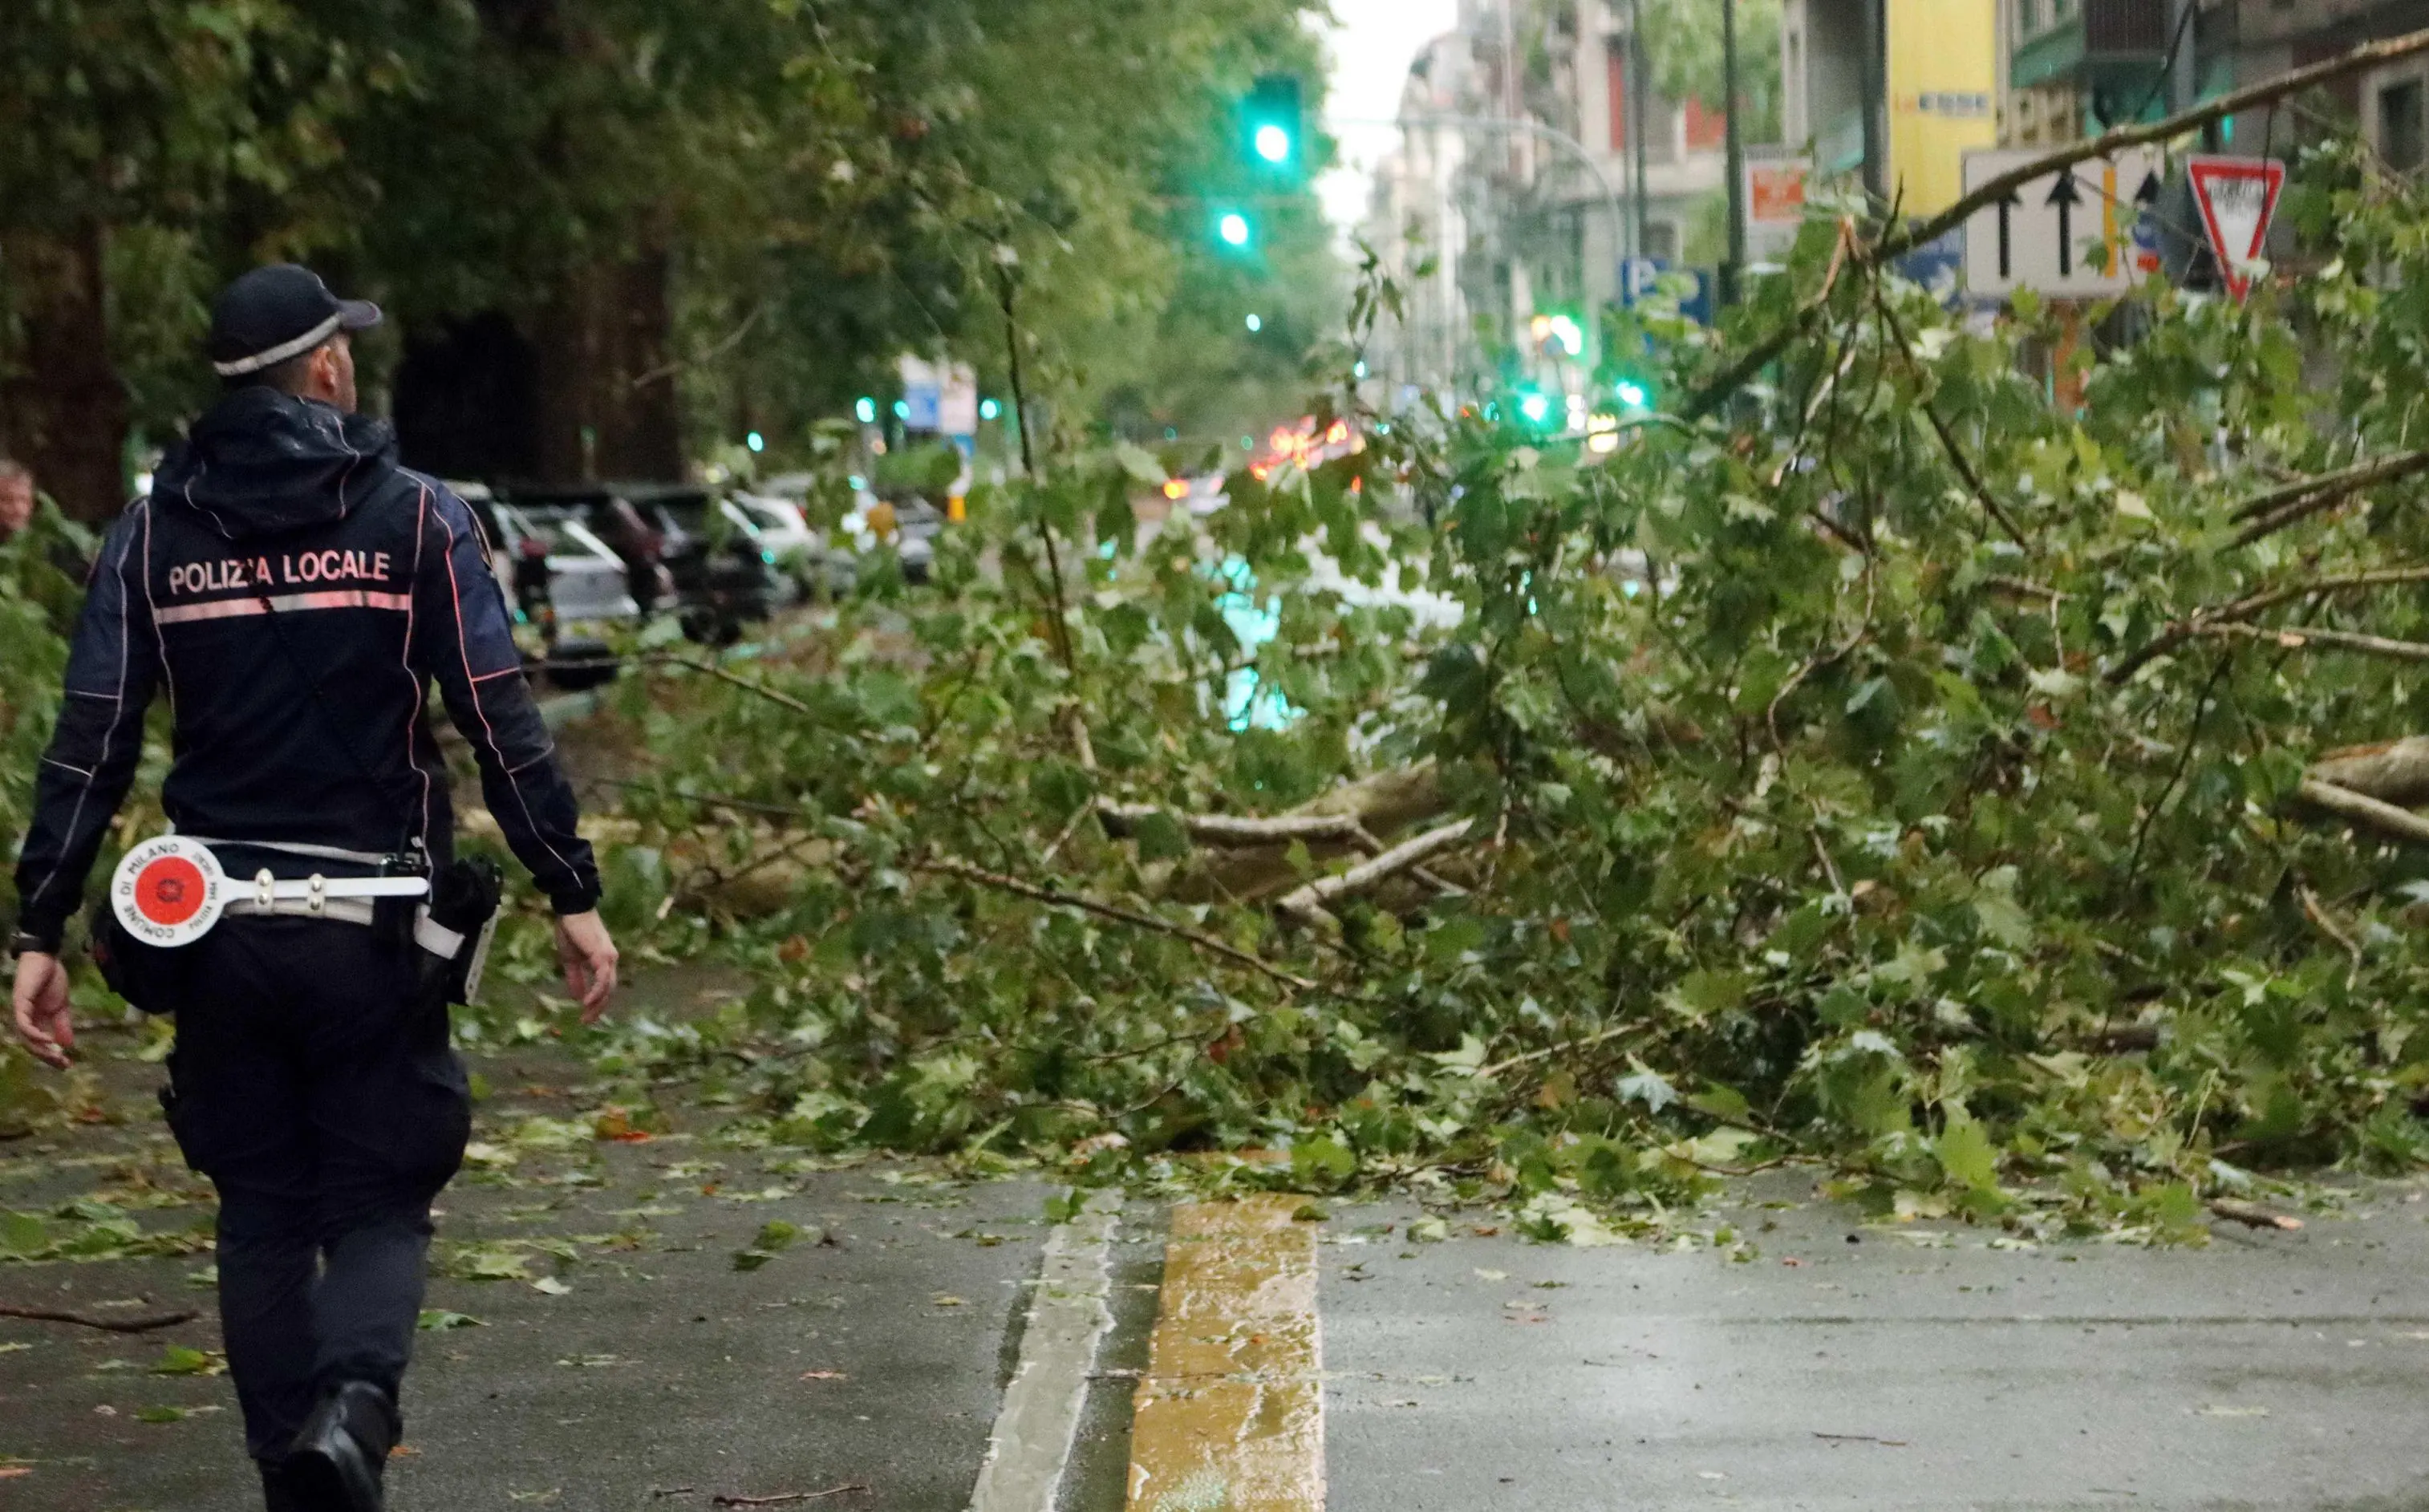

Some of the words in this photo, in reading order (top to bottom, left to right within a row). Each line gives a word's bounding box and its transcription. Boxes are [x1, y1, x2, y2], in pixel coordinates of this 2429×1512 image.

[168, 556, 274, 595] POLIZA
[282, 549, 391, 583] LOCALE
[128, 843, 179, 874] MILANO
[120, 882, 132, 895] DI
[123, 904, 175, 938] COMUNE
